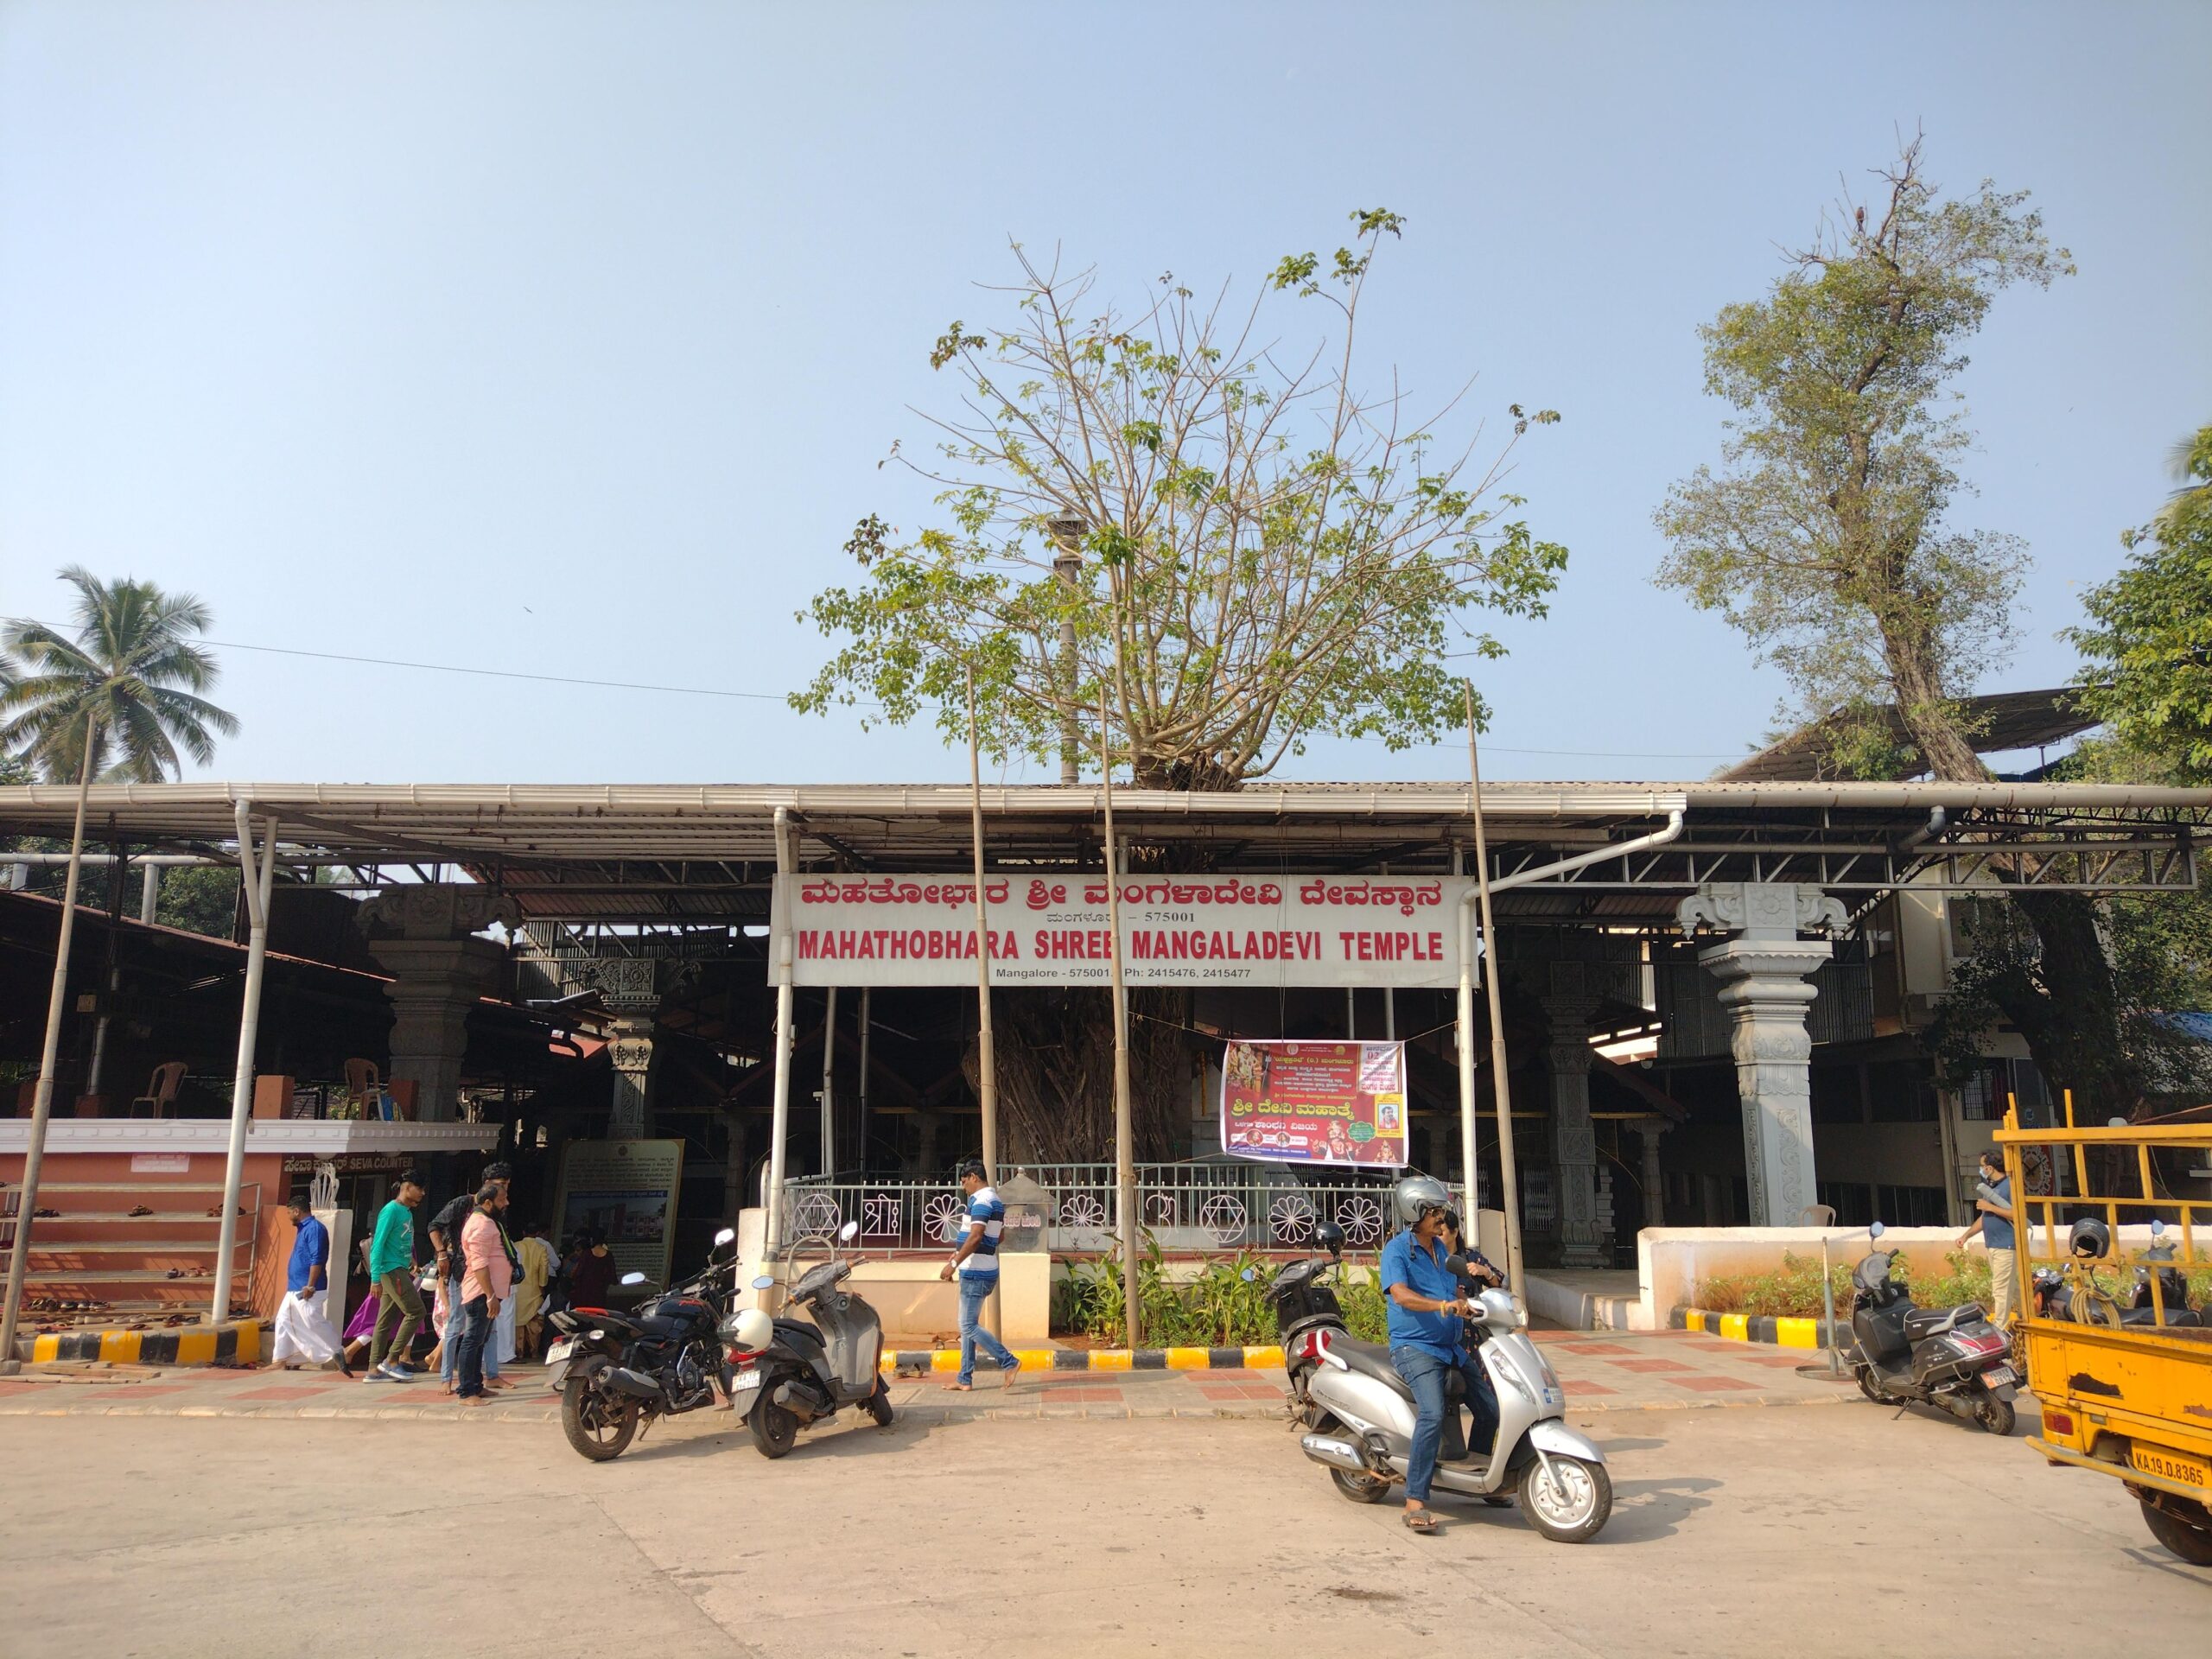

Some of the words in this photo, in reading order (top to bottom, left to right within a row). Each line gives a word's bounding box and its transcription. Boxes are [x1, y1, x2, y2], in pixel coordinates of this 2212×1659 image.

[802, 878, 1009, 908] ಮಹತೋಭಾರ
[1027, 880, 1066, 911] ಶ್ರೀ
[1084, 880, 1282, 905] ಮಂಗಳಾದೇವಿ
[1300, 880, 1442, 917] ದೇವಸ್ಥಾನ
[1145, 912, 1195, 923] 575001
[798, 930, 1019, 959] MAHATHOBHARA
[1034, 930, 1113, 959] SHREE
[1132, 931, 1321, 960] MANGALADEVI
[1340, 931, 1444, 961] TEMPLE
[996, 969, 1058, 980] Mangalore
[1124, 968, 1145, 978] Ph:
[1147, 968, 1199, 980] 2415476,
[1203, 968, 1251, 978] 2415477
[1231, 1098, 1254, 1117] ಶ್ರೀ
[1257, 1099, 1293, 1115] ದೇವಿ
[349, 1156, 373, 1171] SEVA
[374, 1156, 414, 1170] COUNTER
[2135, 1452, 2204, 1486] KA.19.D.8365
